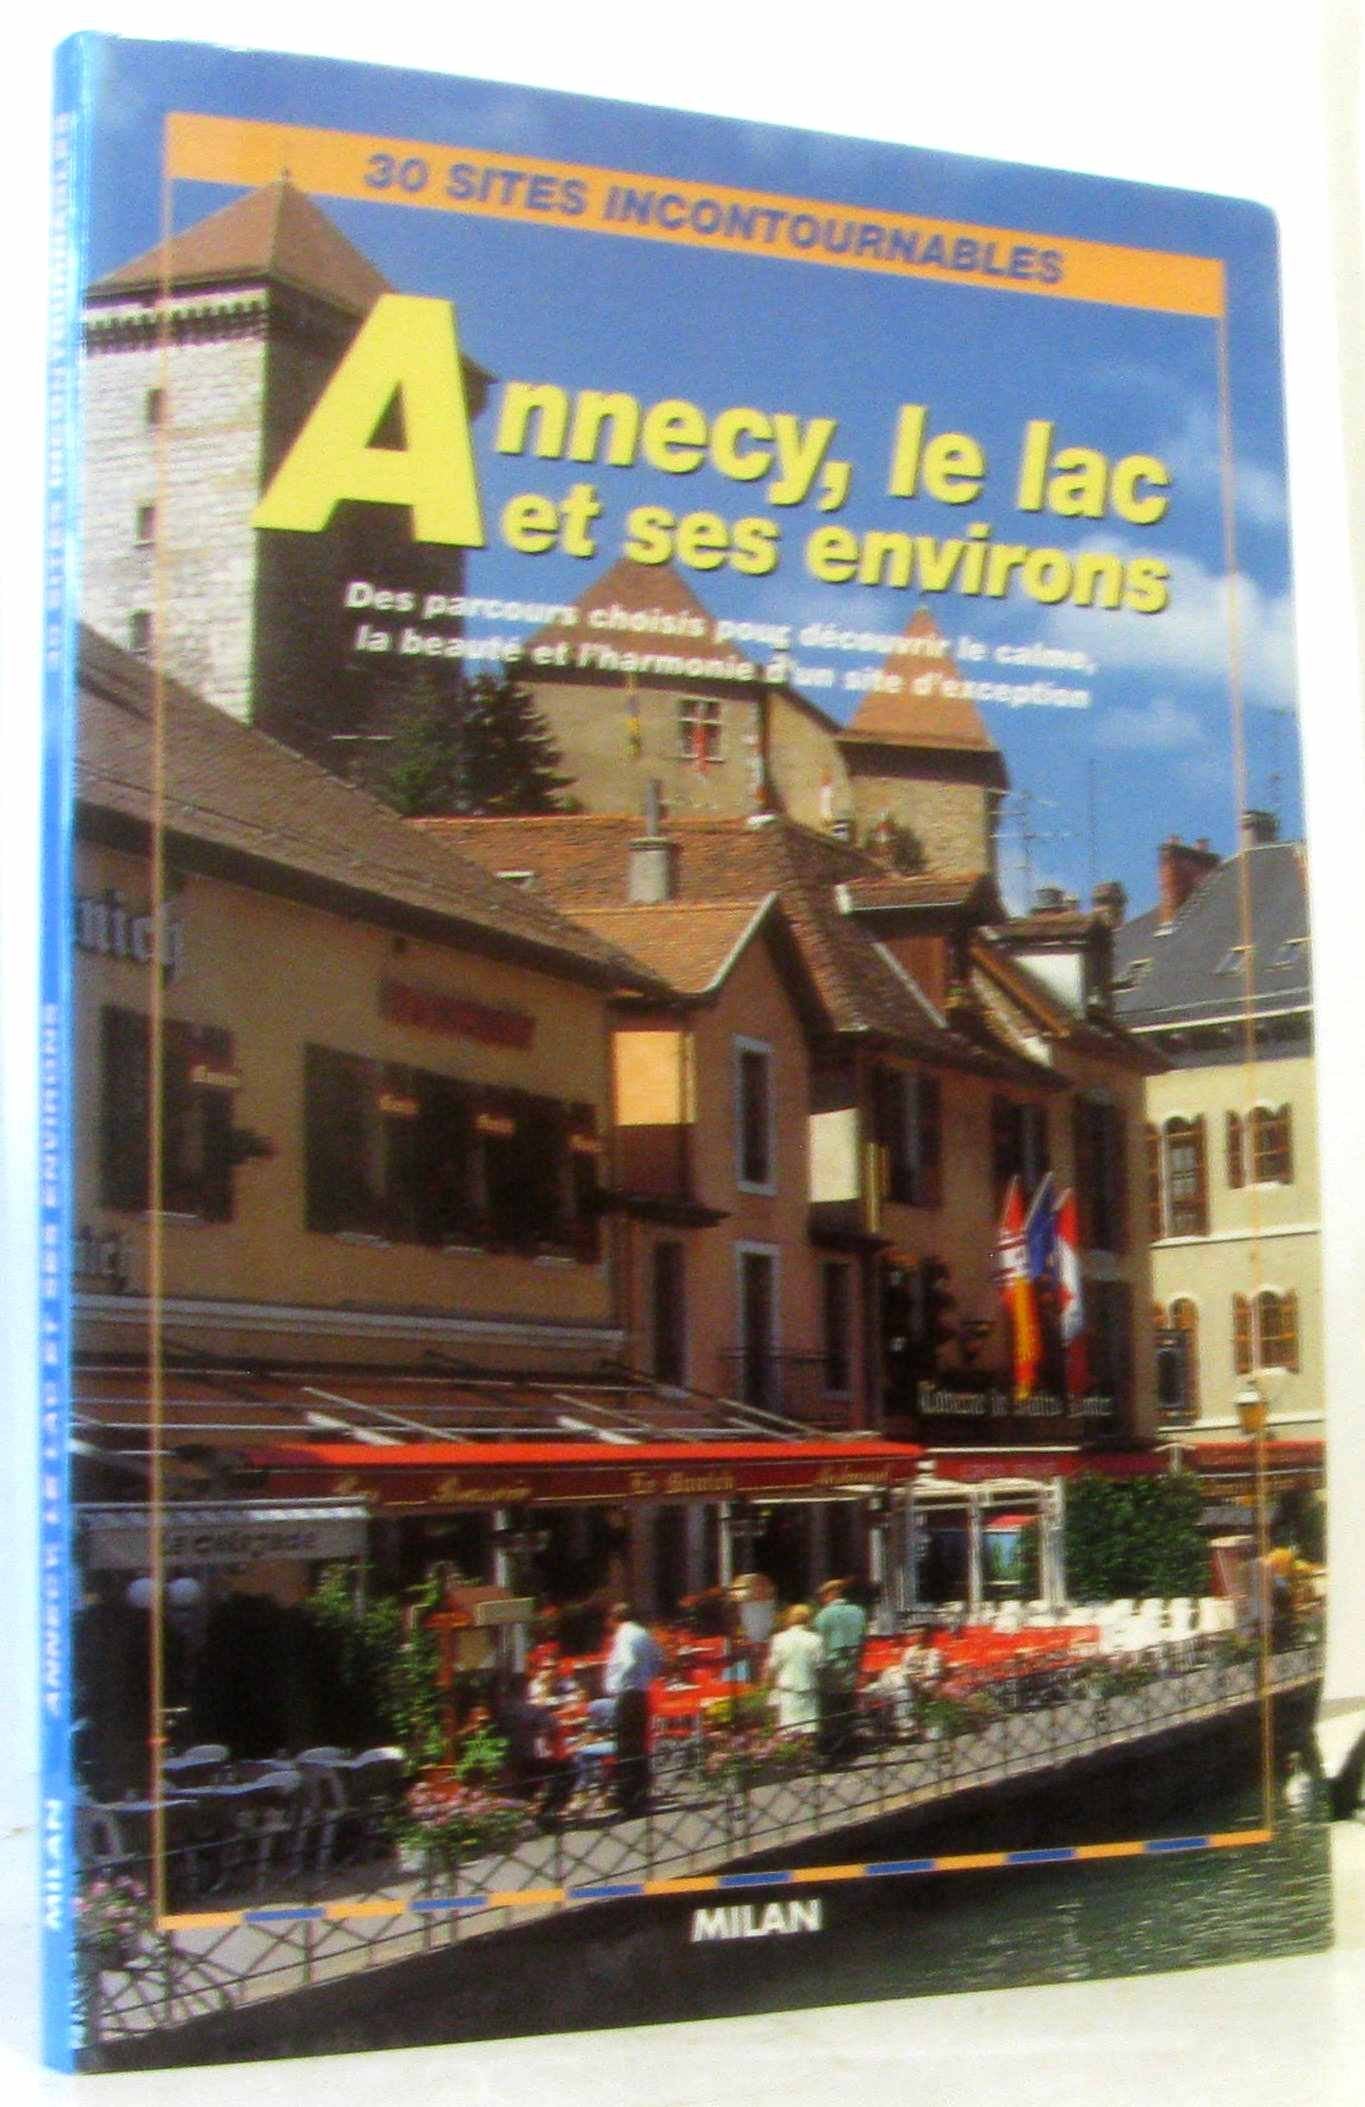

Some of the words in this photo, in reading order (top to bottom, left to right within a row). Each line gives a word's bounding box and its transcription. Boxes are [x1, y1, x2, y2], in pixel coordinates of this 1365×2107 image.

[364, 152, 429, 193] 30
[447, 162, 588, 217] SITES
[601, 184, 1064, 286] INCONTOURNABLES
[252, 293, 852, 548] Annecy,
[889, 404, 986, 505] le
[1017, 418, 1172, 525] lac
[502, 482, 603, 558] et
[624, 504, 782, 576] ses
[805, 522, 1171, 615] environs
[346, 580, 416, 613] Des
[421, 594, 581, 627] parcours
[587, 602, 707, 639] choisis
[799, 621, 950, 658] découvrir
[957, 635, 988, 662] le
[355, 624, 393, 653] la
[401, 625, 524, 663] beauté
[529, 641, 572, 667] et
[576, 641, 756, 682] l'harmonie
[844, 665, 904, 694] site
[46, 1798, 64, 1933] MILAN
[692, 1898, 821, 1942] MILAN
